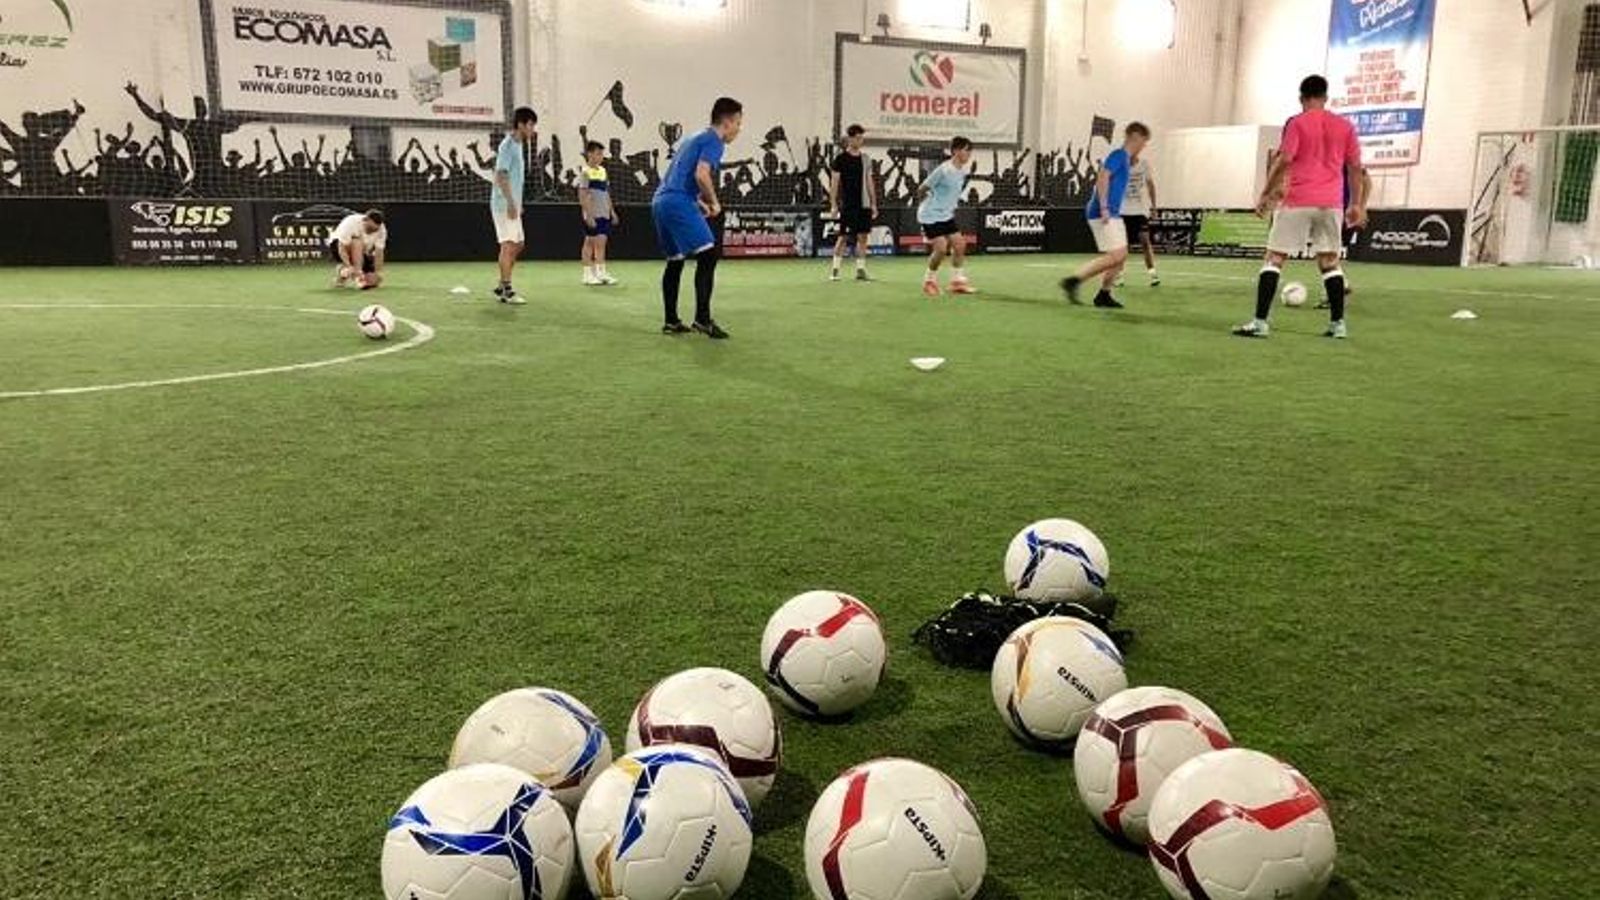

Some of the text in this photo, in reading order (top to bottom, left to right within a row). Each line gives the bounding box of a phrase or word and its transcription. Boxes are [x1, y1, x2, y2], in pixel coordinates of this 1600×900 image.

[234, 16, 393, 50] ECOMASA
[293, 68, 320, 81] 672
[327, 70, 352, 83] 102
[356, 72, 382, 85] 010
[879, 91, 980, 118] romeral
[174, 206, 233, 226] ISIS
[985, 213, 1045, 230] REACTION
